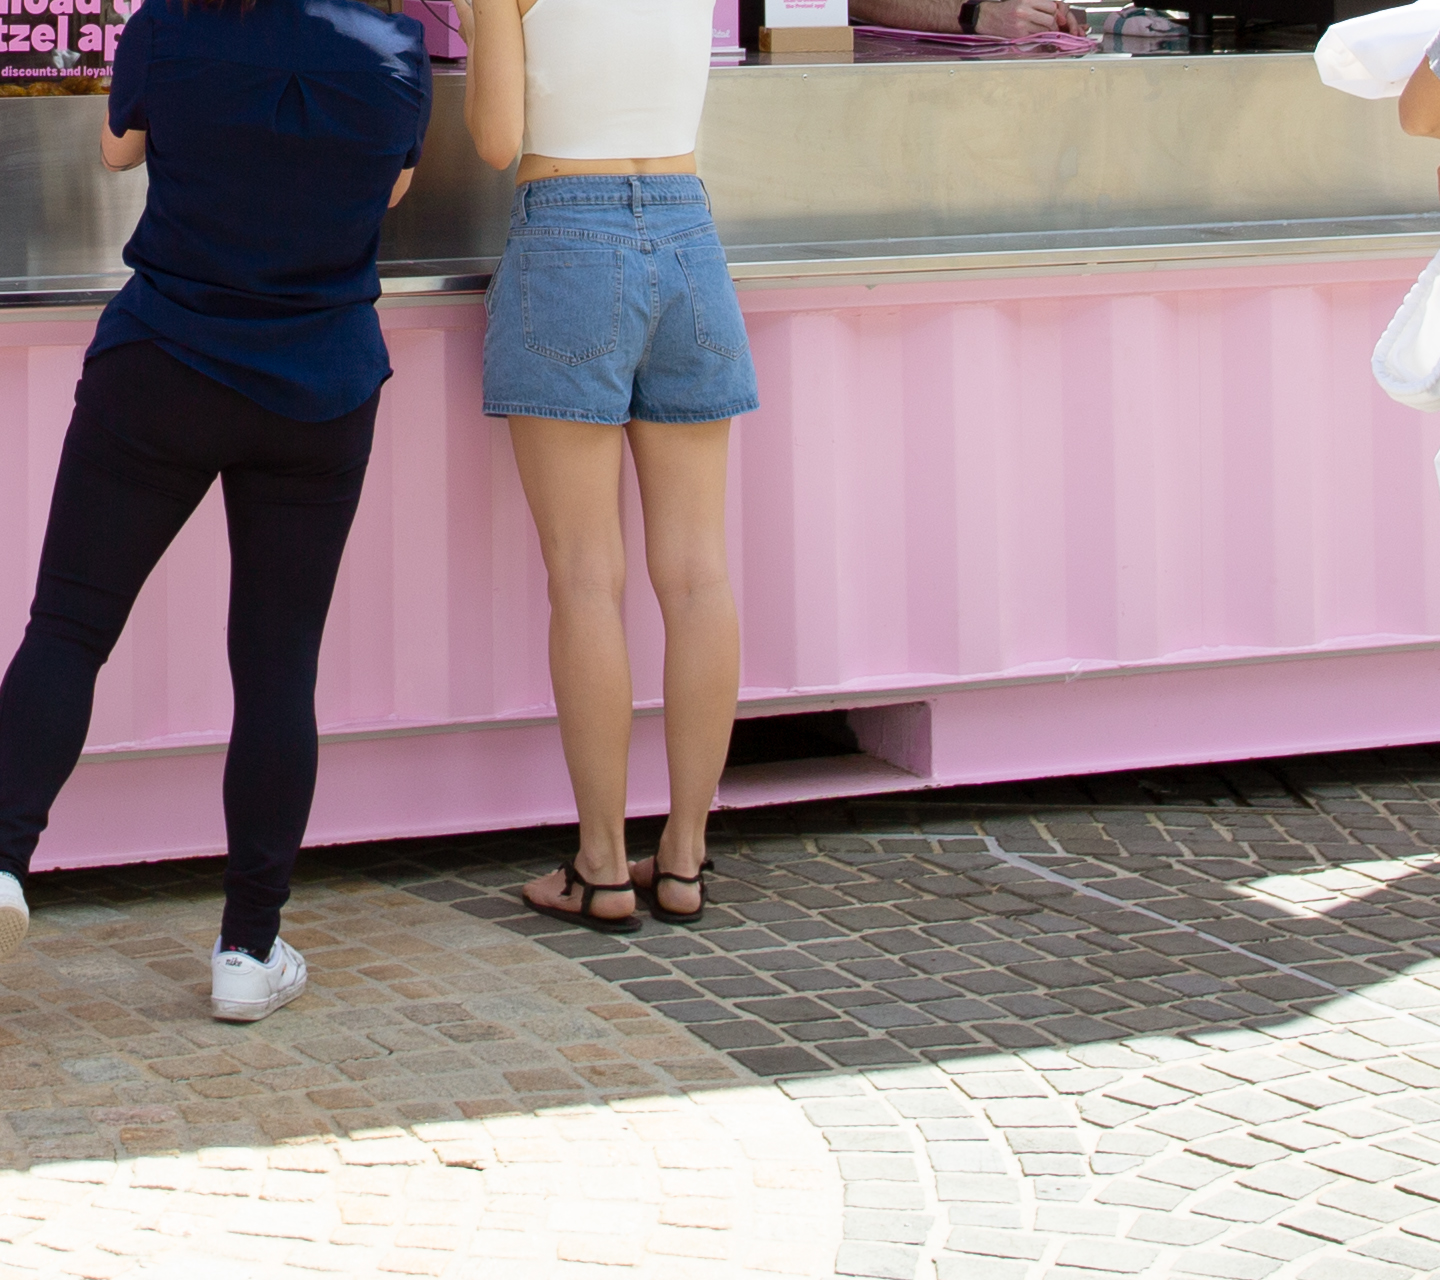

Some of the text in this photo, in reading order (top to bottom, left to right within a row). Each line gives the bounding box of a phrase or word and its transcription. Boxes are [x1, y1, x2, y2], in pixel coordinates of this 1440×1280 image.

[78, 23, 125, 61] ap
[1, 66, 57, 77] discounts
[60, 66, 81, 77] and
[224, 957, 243, 968] nike
